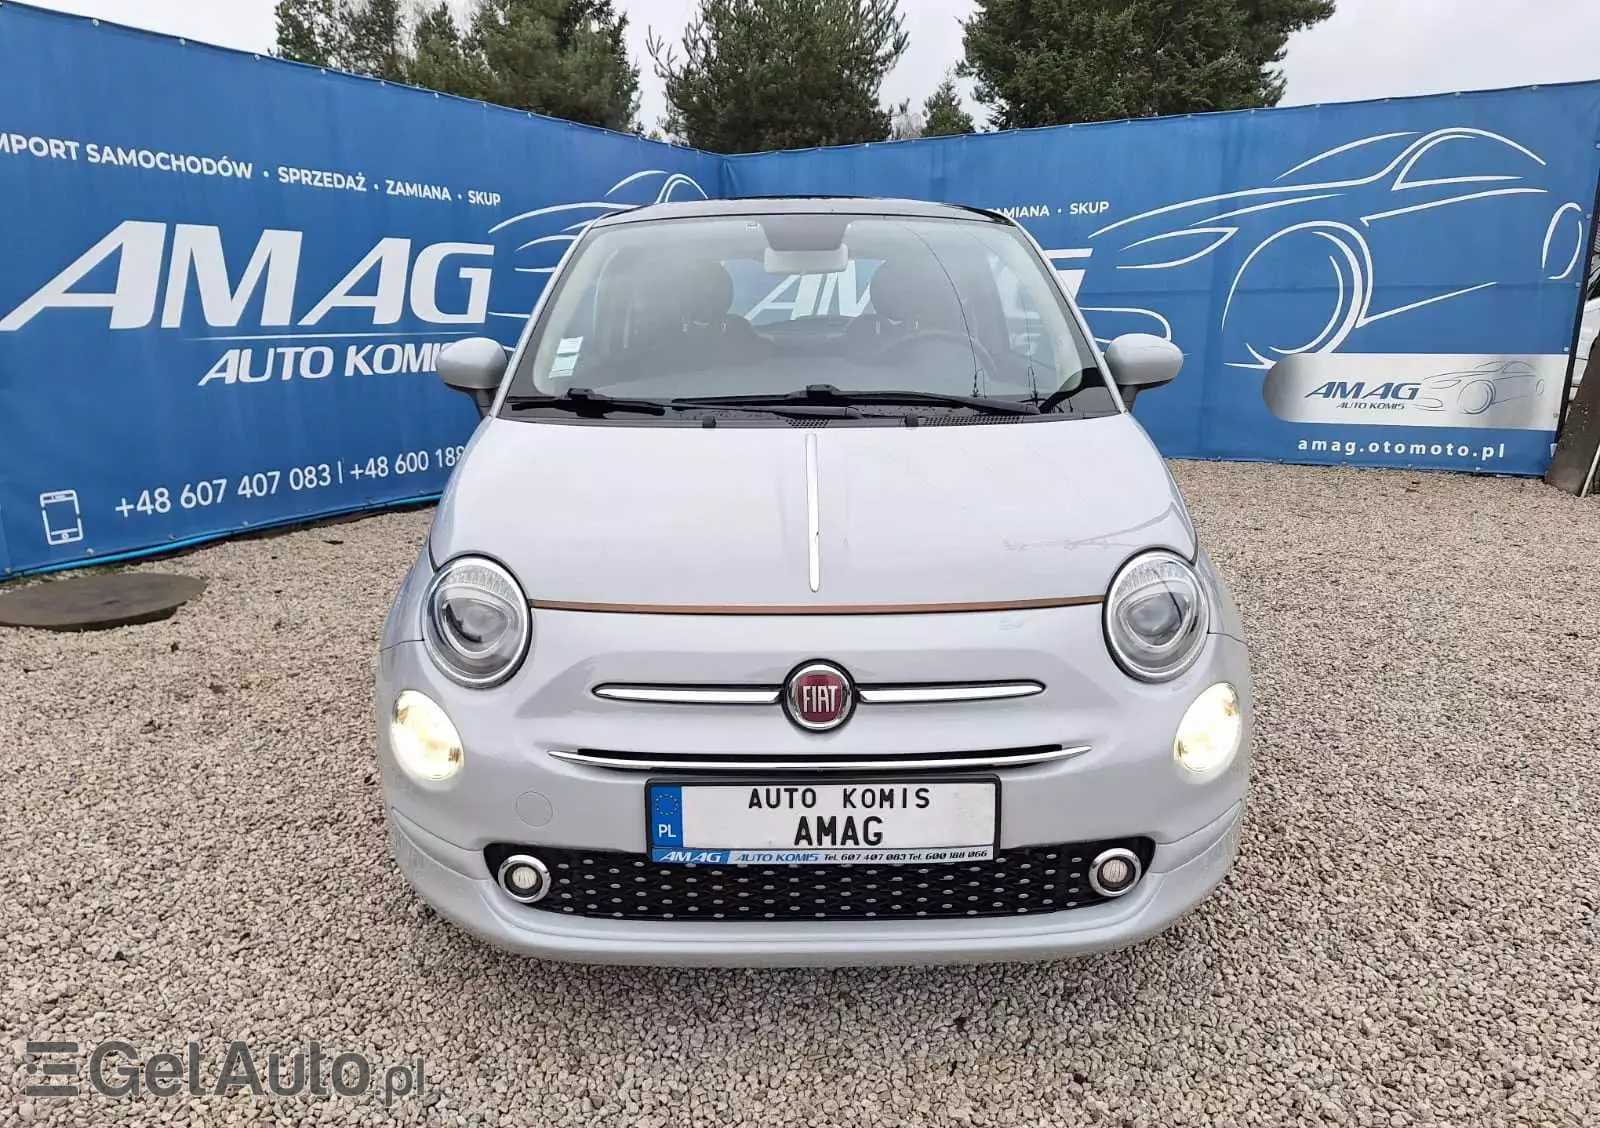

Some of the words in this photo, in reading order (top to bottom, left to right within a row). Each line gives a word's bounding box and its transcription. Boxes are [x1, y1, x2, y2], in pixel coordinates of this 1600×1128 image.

[86, 143, 253, 180] SAMOCHODÓW
[277, 166, 367, 192] SPRZEDAŻ
[385, 179, 452, 201] ZAMIANA
[468, 190, 501, 206] SKUP
[1069, 201, 1110, 215] SKUP
[0, 220, 495, 331] AMAG
[197, 345, 334, 386] AUTO
[344, 342, 456, 377] KOMI
[1304, 381, 1421, 401] AMAG
[1336, 402, 1368, 410] AUTO
[1369, 402, 1405, 410] KOMIS
[1298, 438, 1505, 460] amag.otomoto.pl
[115, 487, 171, 518] +48
[180, 478, 227, 510] 607
[237, 470, 281, 499] 407
[289, 463, 331, 491] 083
[350, 456, 389, 480] +48
[395, 450, 429, 475] 600
[803, 685, 838, 713] FIAT
[749, 787, 817, 809] AUTO
[844, 787, 931, 809] KOMIS
[658, 823, 677, 838] PL
[794, 815, 884, 846] AMAG
[660, 850, 722, 863] AMAG
[736, 853, 773, 863] AUTO
[775, 852, 820, 862] KOMIS
[841, 853, 860, 861] 607
[864, 853, 883, 861] 407
[886, 853, 906, 861] 083
[925, 852, 947, 860] 600
[950, 851, 965, 859] 188
[968, 850, 988, 858] 066
